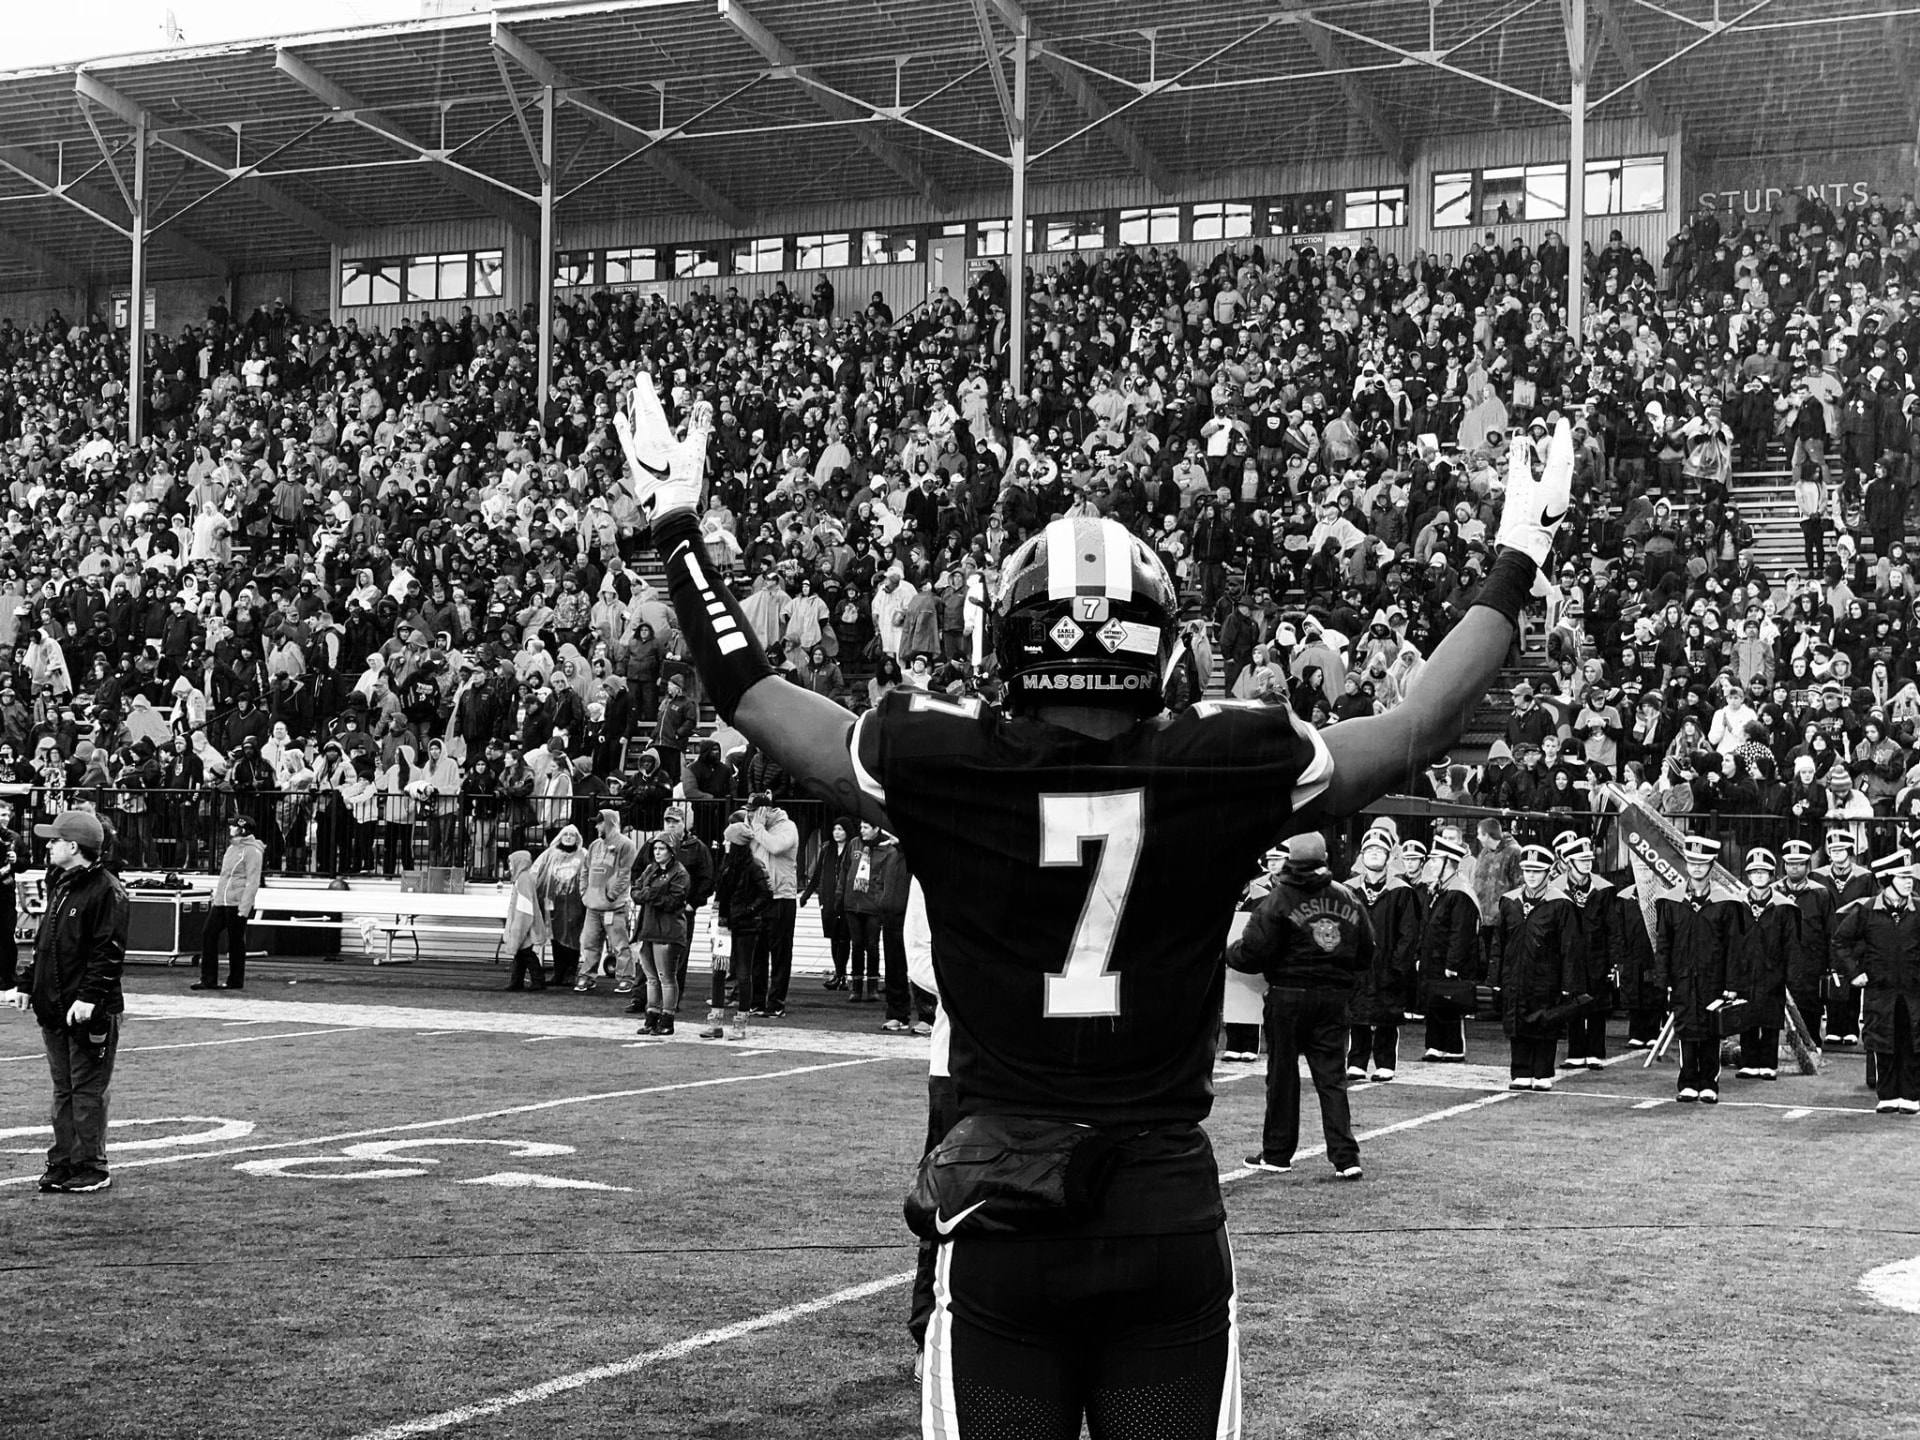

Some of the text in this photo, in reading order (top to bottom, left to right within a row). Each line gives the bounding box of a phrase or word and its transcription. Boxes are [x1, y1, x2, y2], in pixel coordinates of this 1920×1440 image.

[1698, 182, 1869, 215] STUDNTS
[1293, 236, 1323, 245] SECTION
[115, 299, 128, 329] 5
[1082, 598, 1101, 620] 7
[1022, 674, 1155, 690] MASSILLON
[1037, 786, 1146, 1019] 7
[1287, 897, 1361, 928] MASSILLON
